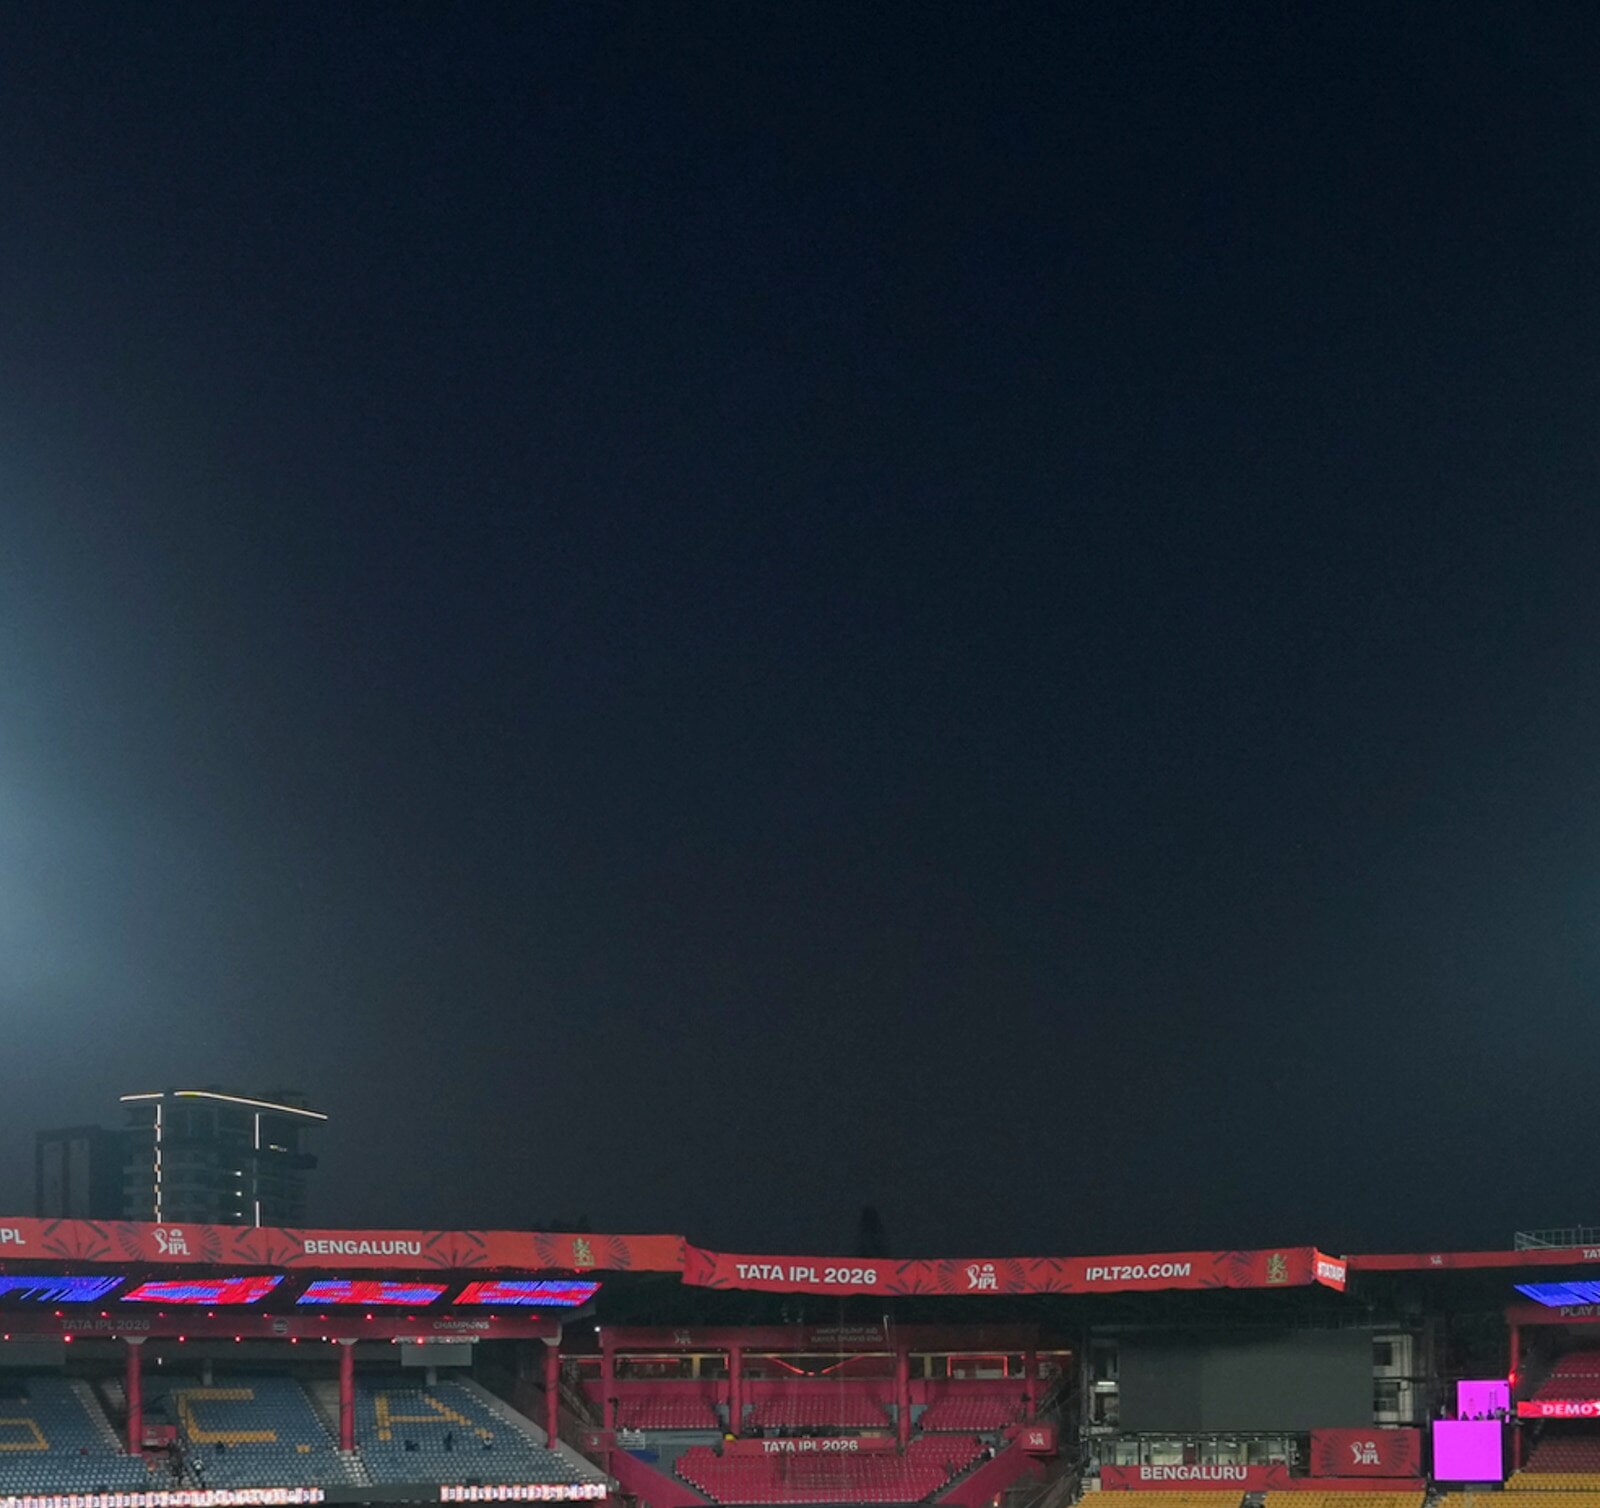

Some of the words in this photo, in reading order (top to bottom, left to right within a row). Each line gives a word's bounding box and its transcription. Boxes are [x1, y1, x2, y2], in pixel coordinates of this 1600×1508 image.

[168, 1242, 191, 1256] IPL
[303, 1239, 421, 1256] BENGALURU
[736, 1264, 784, 1281] TATA
[789, 1267, 820, 1283] IPL
[824, 1268, 877, 1284] 2026
[1086, 1263, 1191, 1281] IPLT20.COM
[978, 1277, 999, 1290] IPL
[1560, 1305, 1594, 1317] PLAY
[61, 1318, 92, 1331] TATA
[117, 1319, 150, 1332] 2026
[1541, 1403, 1593, 1416] DEMO
[762, 1441, 795, 1453] TATA
[799, 1440, 819, 1452] IPL
[822, 1439, 858, 1451] 2026
[1140, 1466, 1247, 1481] BENGALURU
